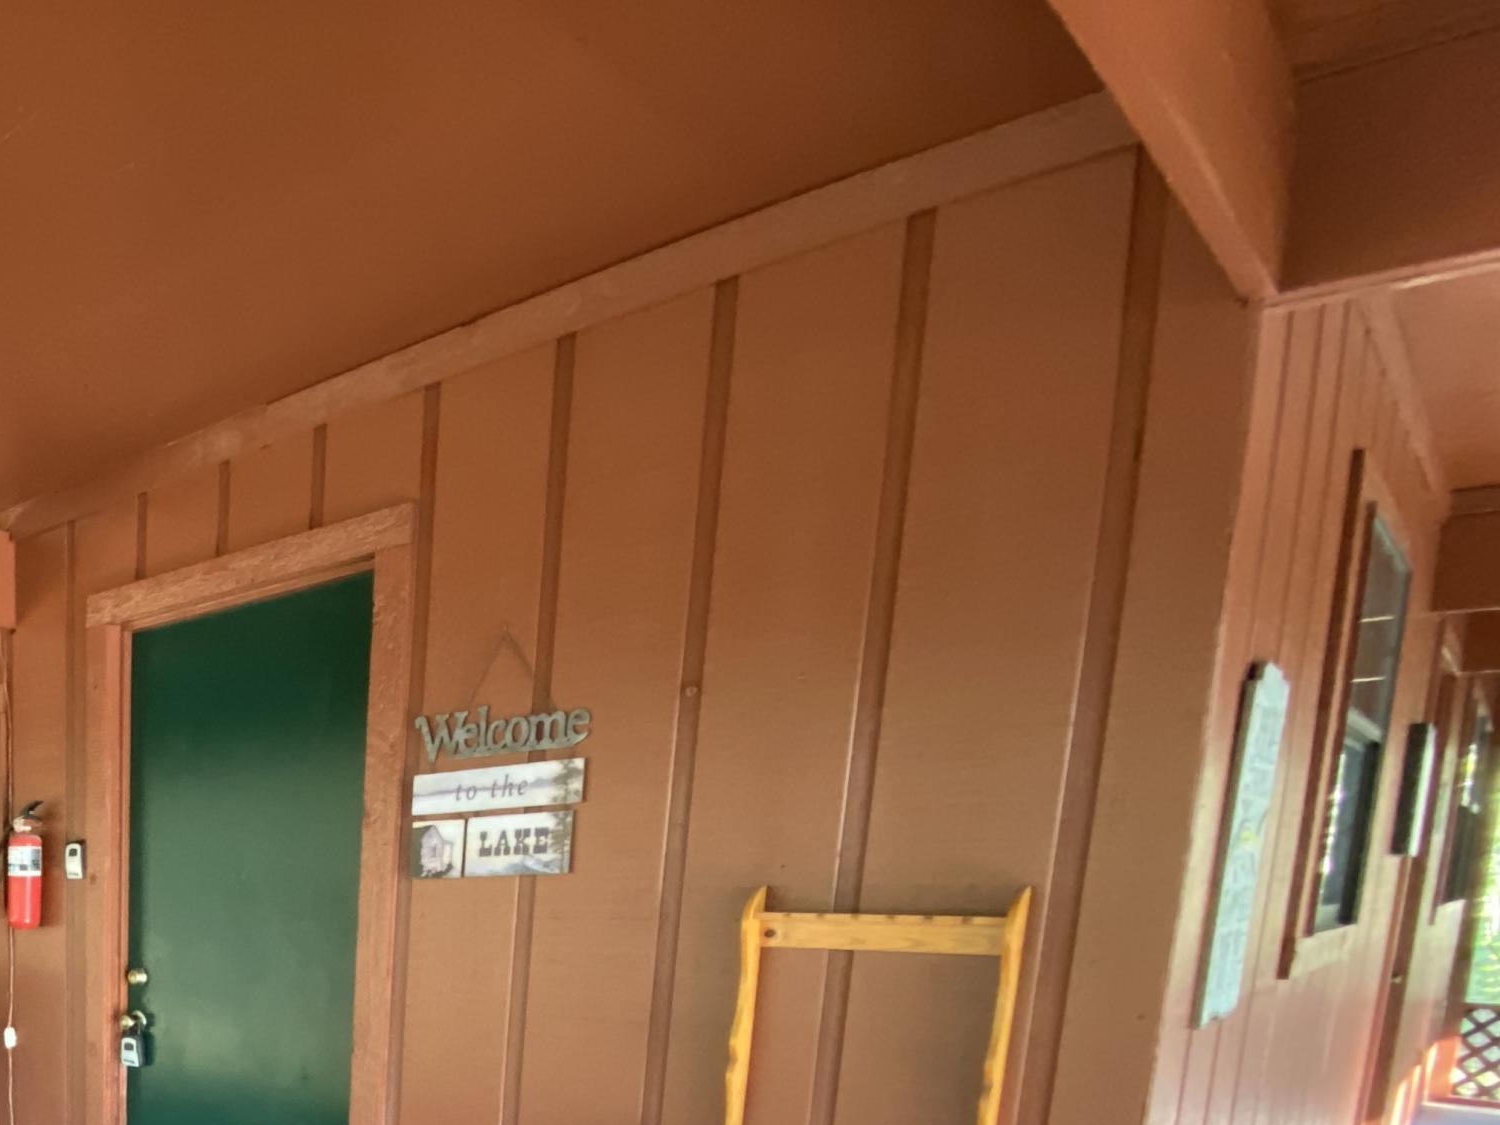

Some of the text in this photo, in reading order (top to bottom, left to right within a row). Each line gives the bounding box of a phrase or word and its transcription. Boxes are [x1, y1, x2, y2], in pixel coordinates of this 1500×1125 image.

[414, 704, 591, 764] Welcome
[455, 774, 529, 801] to the
[478, 827, 550, 858] LAKE
